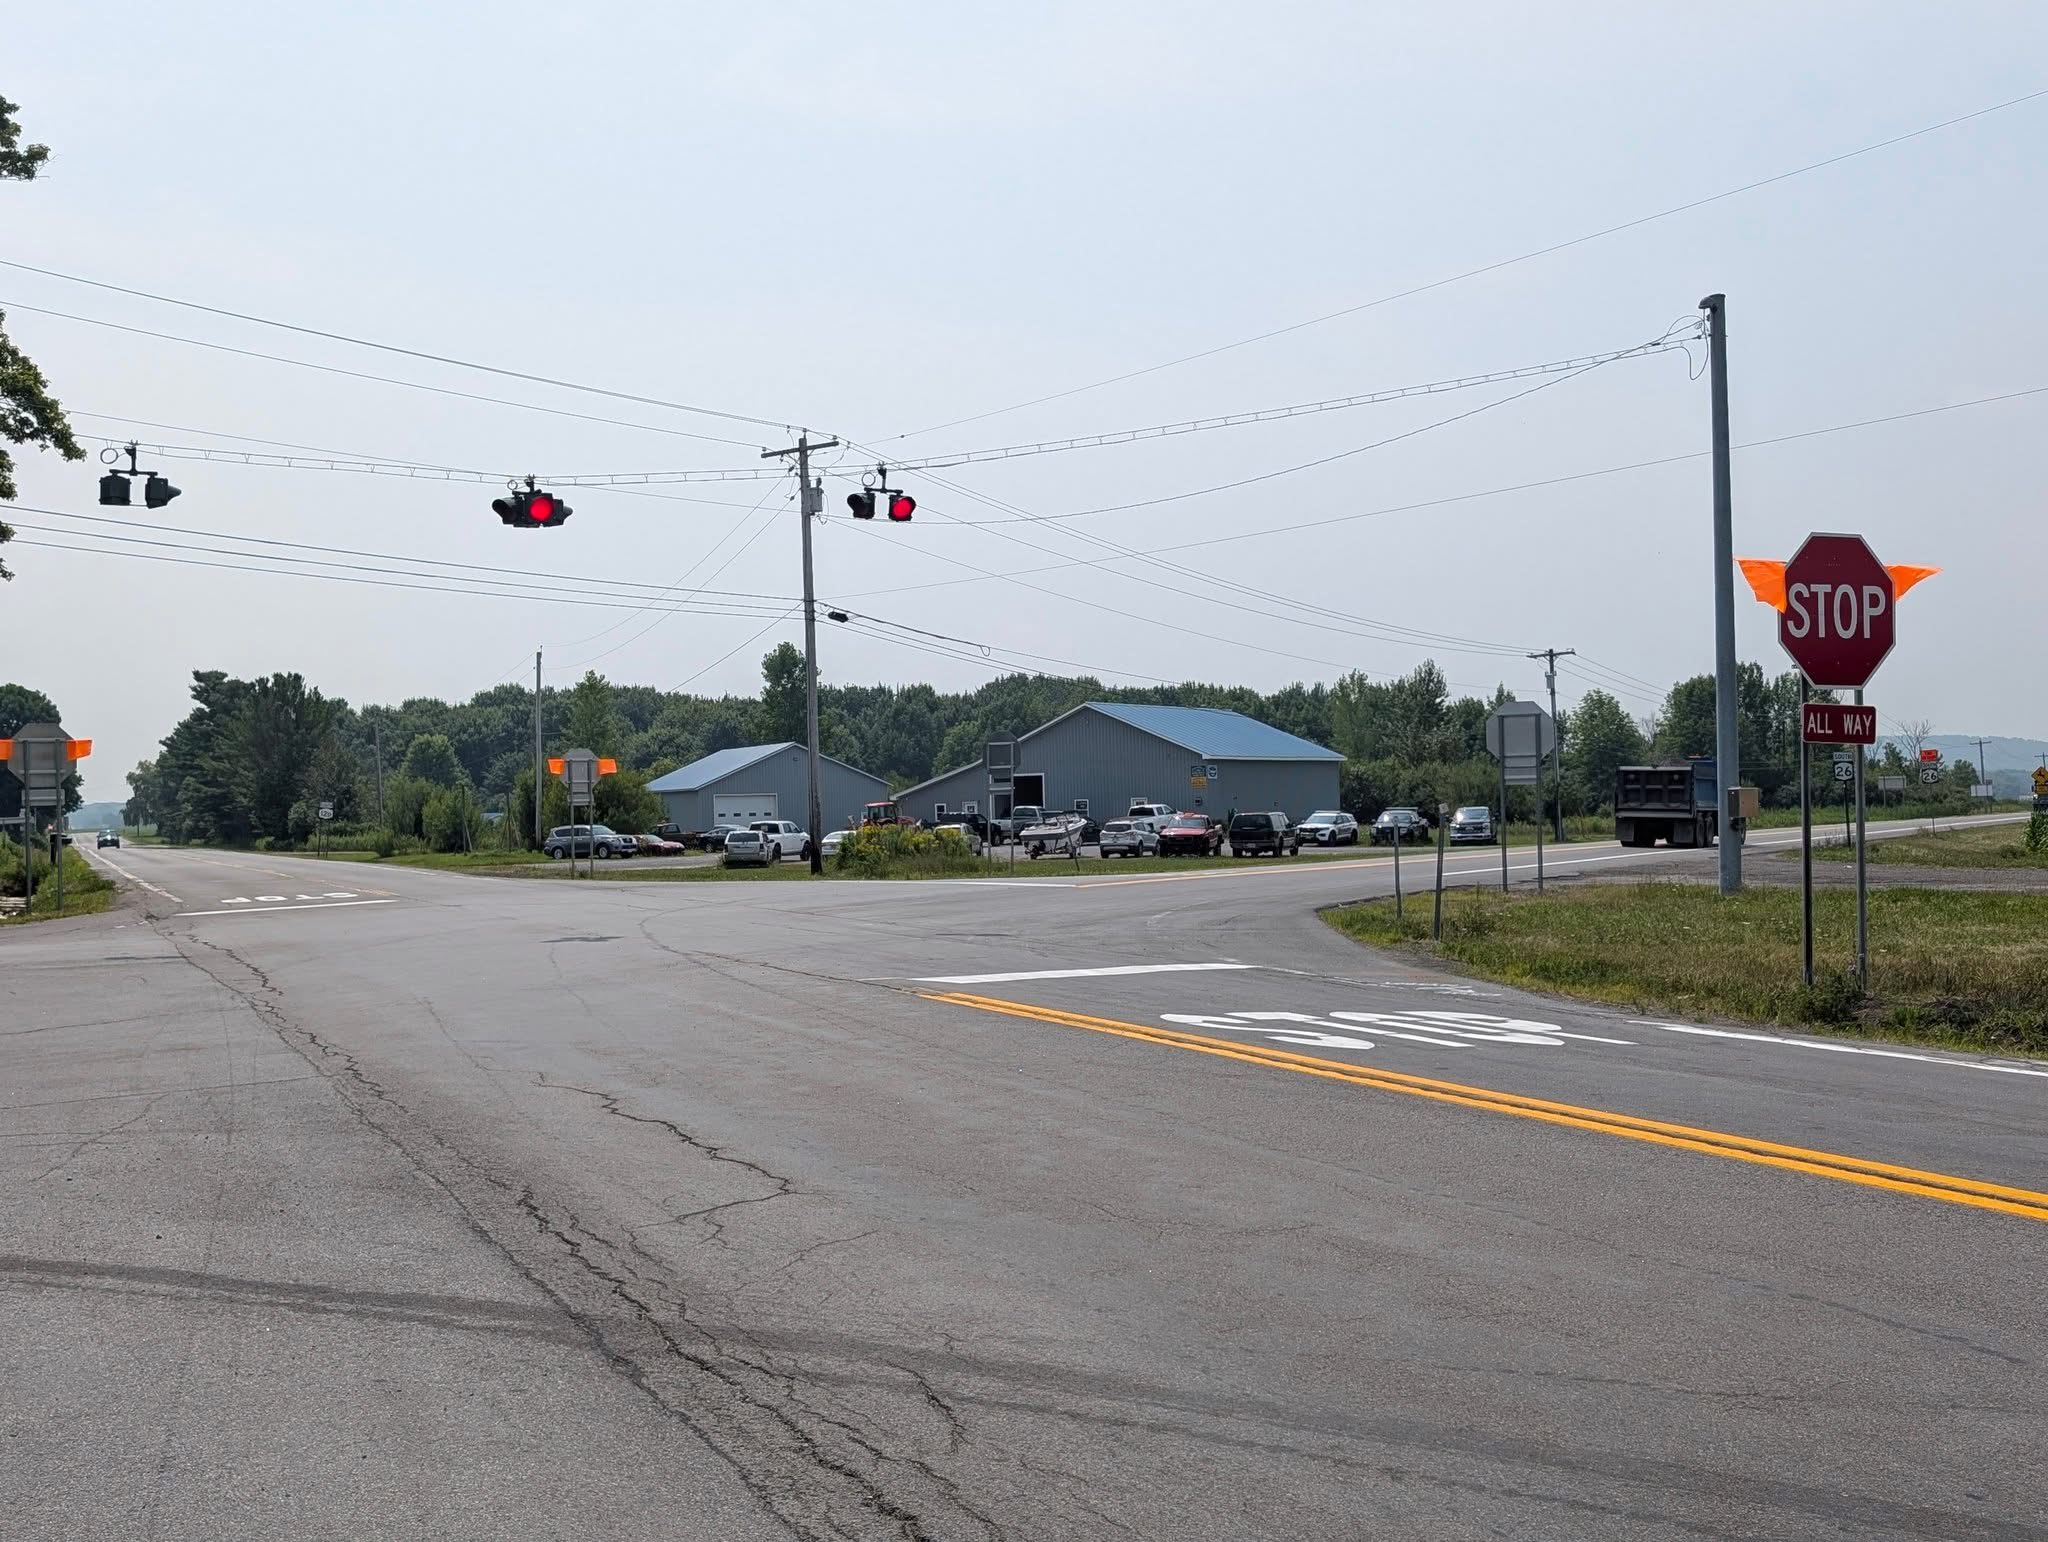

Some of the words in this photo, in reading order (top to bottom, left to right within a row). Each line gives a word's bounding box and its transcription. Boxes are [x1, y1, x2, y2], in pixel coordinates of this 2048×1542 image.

[1787, 583, 1886, 639] STOP
[1808, 712, 1833, 734] ALL
[1843, 714, 1872, 736] WAY
[1836, 766, 1852, 777] 26
[1924, 772, 1937, 781] 26
[221, 892, 358, 904] STOP
[1160, 1011, 1638, 1050] STOP
